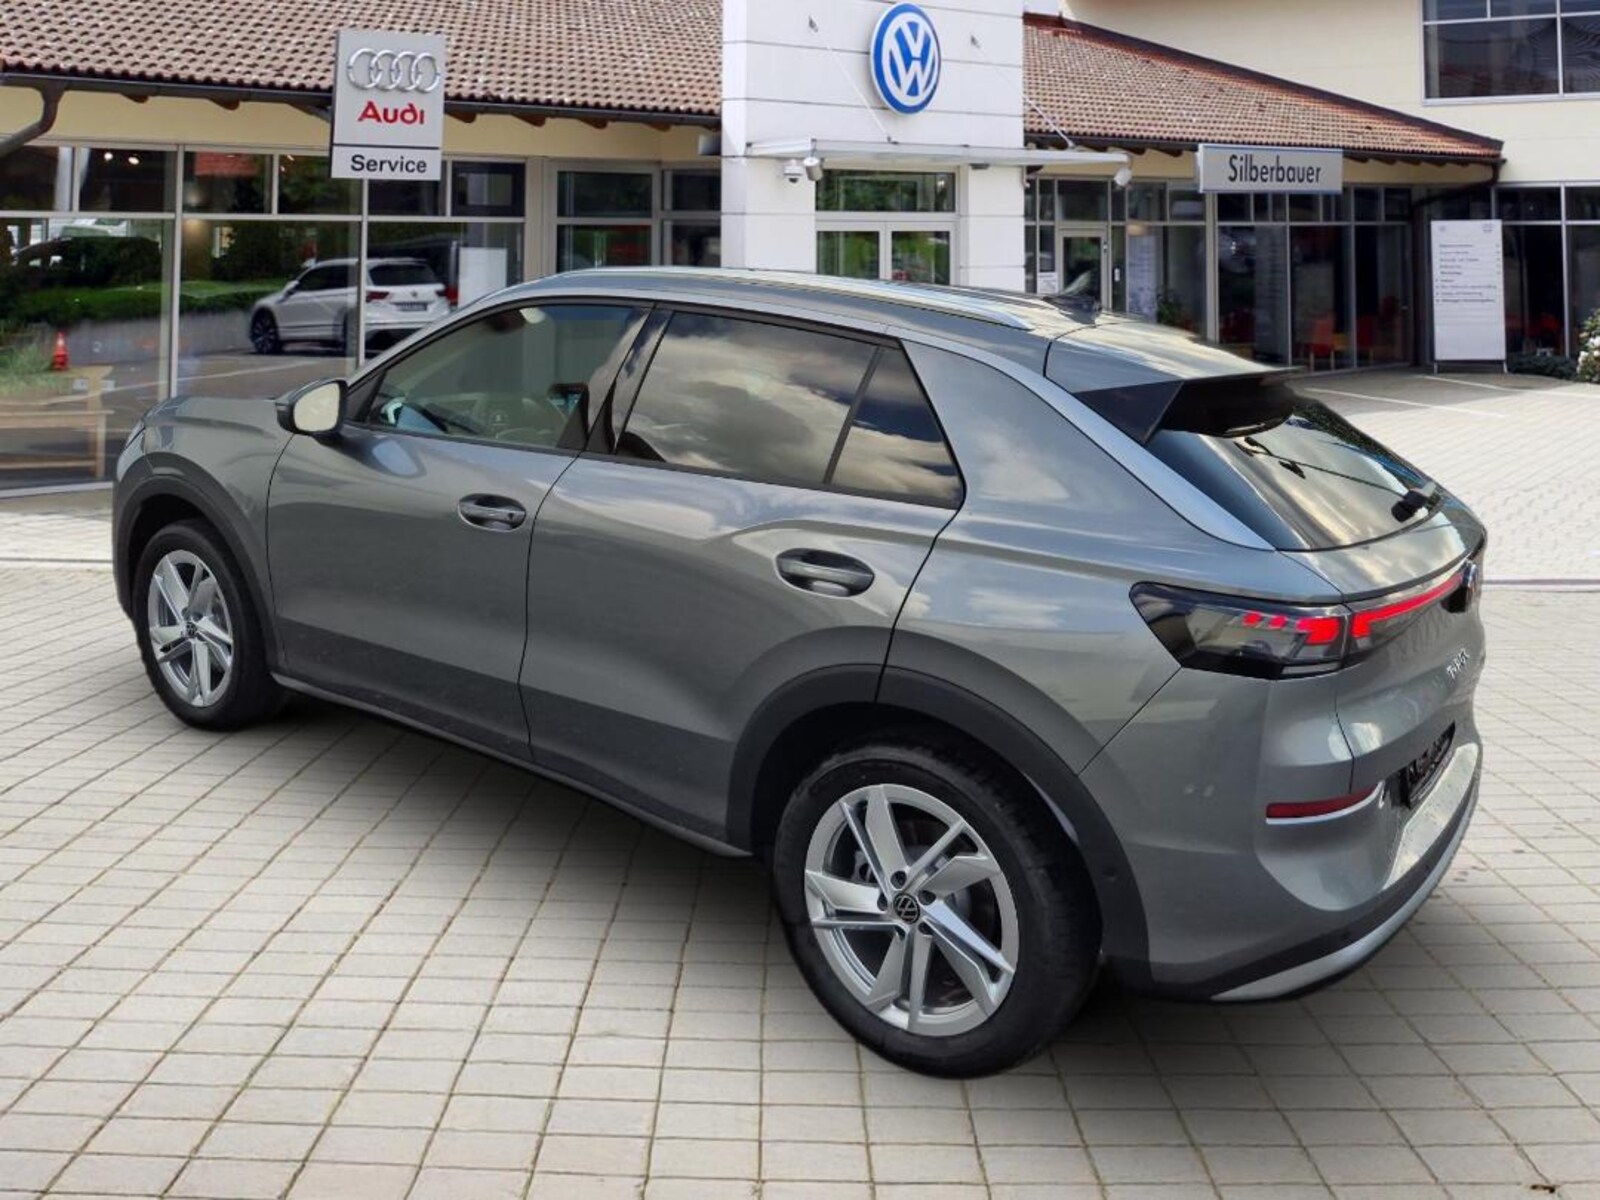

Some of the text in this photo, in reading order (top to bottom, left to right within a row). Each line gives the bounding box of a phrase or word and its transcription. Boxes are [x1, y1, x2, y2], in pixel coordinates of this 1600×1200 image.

[879, 8, 938, 109] VW
[357, 100, 425, 125] Audi
[350, 154, 427, 173] Service
[1228, 154, 1321, 183] Silberbauer
